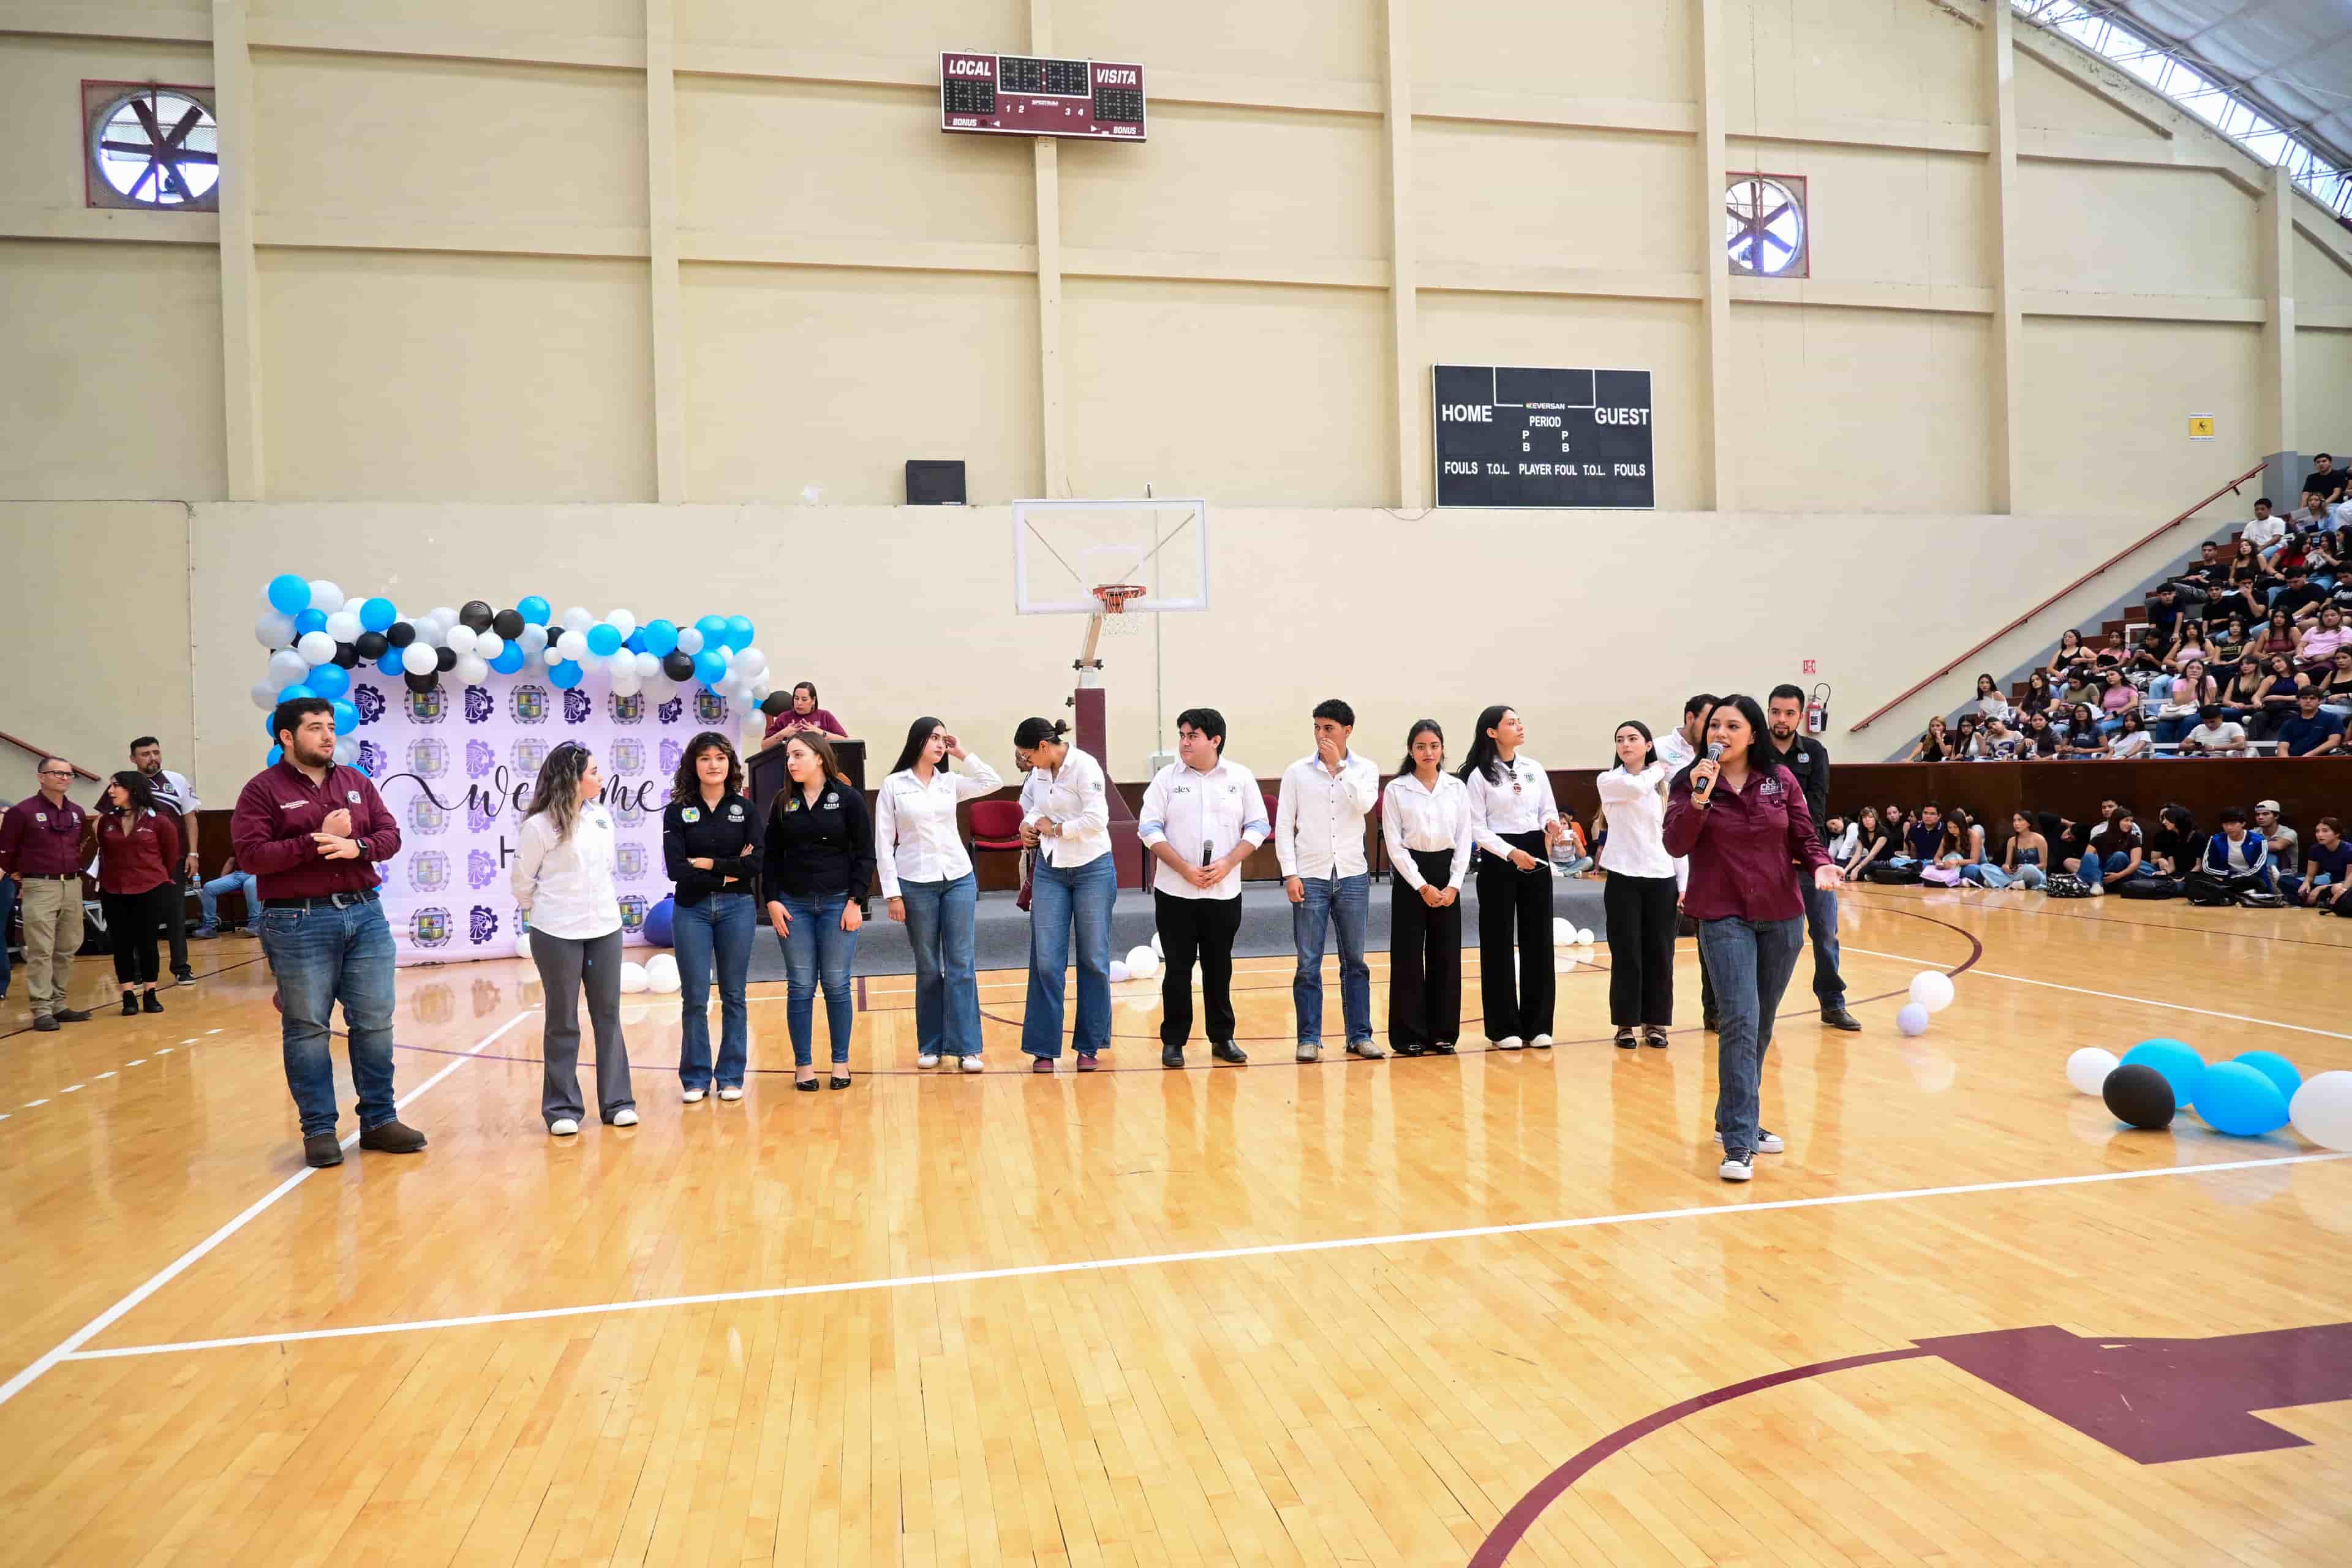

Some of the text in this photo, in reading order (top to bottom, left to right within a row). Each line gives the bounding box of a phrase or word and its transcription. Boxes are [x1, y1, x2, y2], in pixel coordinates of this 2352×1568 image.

[949, 59, 991, 76] LOCAL
[1097, 69, 1136, 85] VISITA
[1006, 104, 1025, 113] 1 2
[1065, 107, 1084, 116] 3 4
[952, 118, 977, 127] BONUS
[1113, 126, 1136, 135] BONUS
[1442, 404, 1493, 422] HOME
[1594, 408, 1649, 425] GUEST
[1529, 416, 1561, 427] PERIOD
[1522, 430, 1529, 440] P
[1561, 431, 1569, 440] P
[1523, 442, 1531, 452] B
[1562, 443, 1570, 453] B
[1445, 462, 1646, 477] FOULS T.O.L. PLAYER FOUL T.O.L. FOULS
